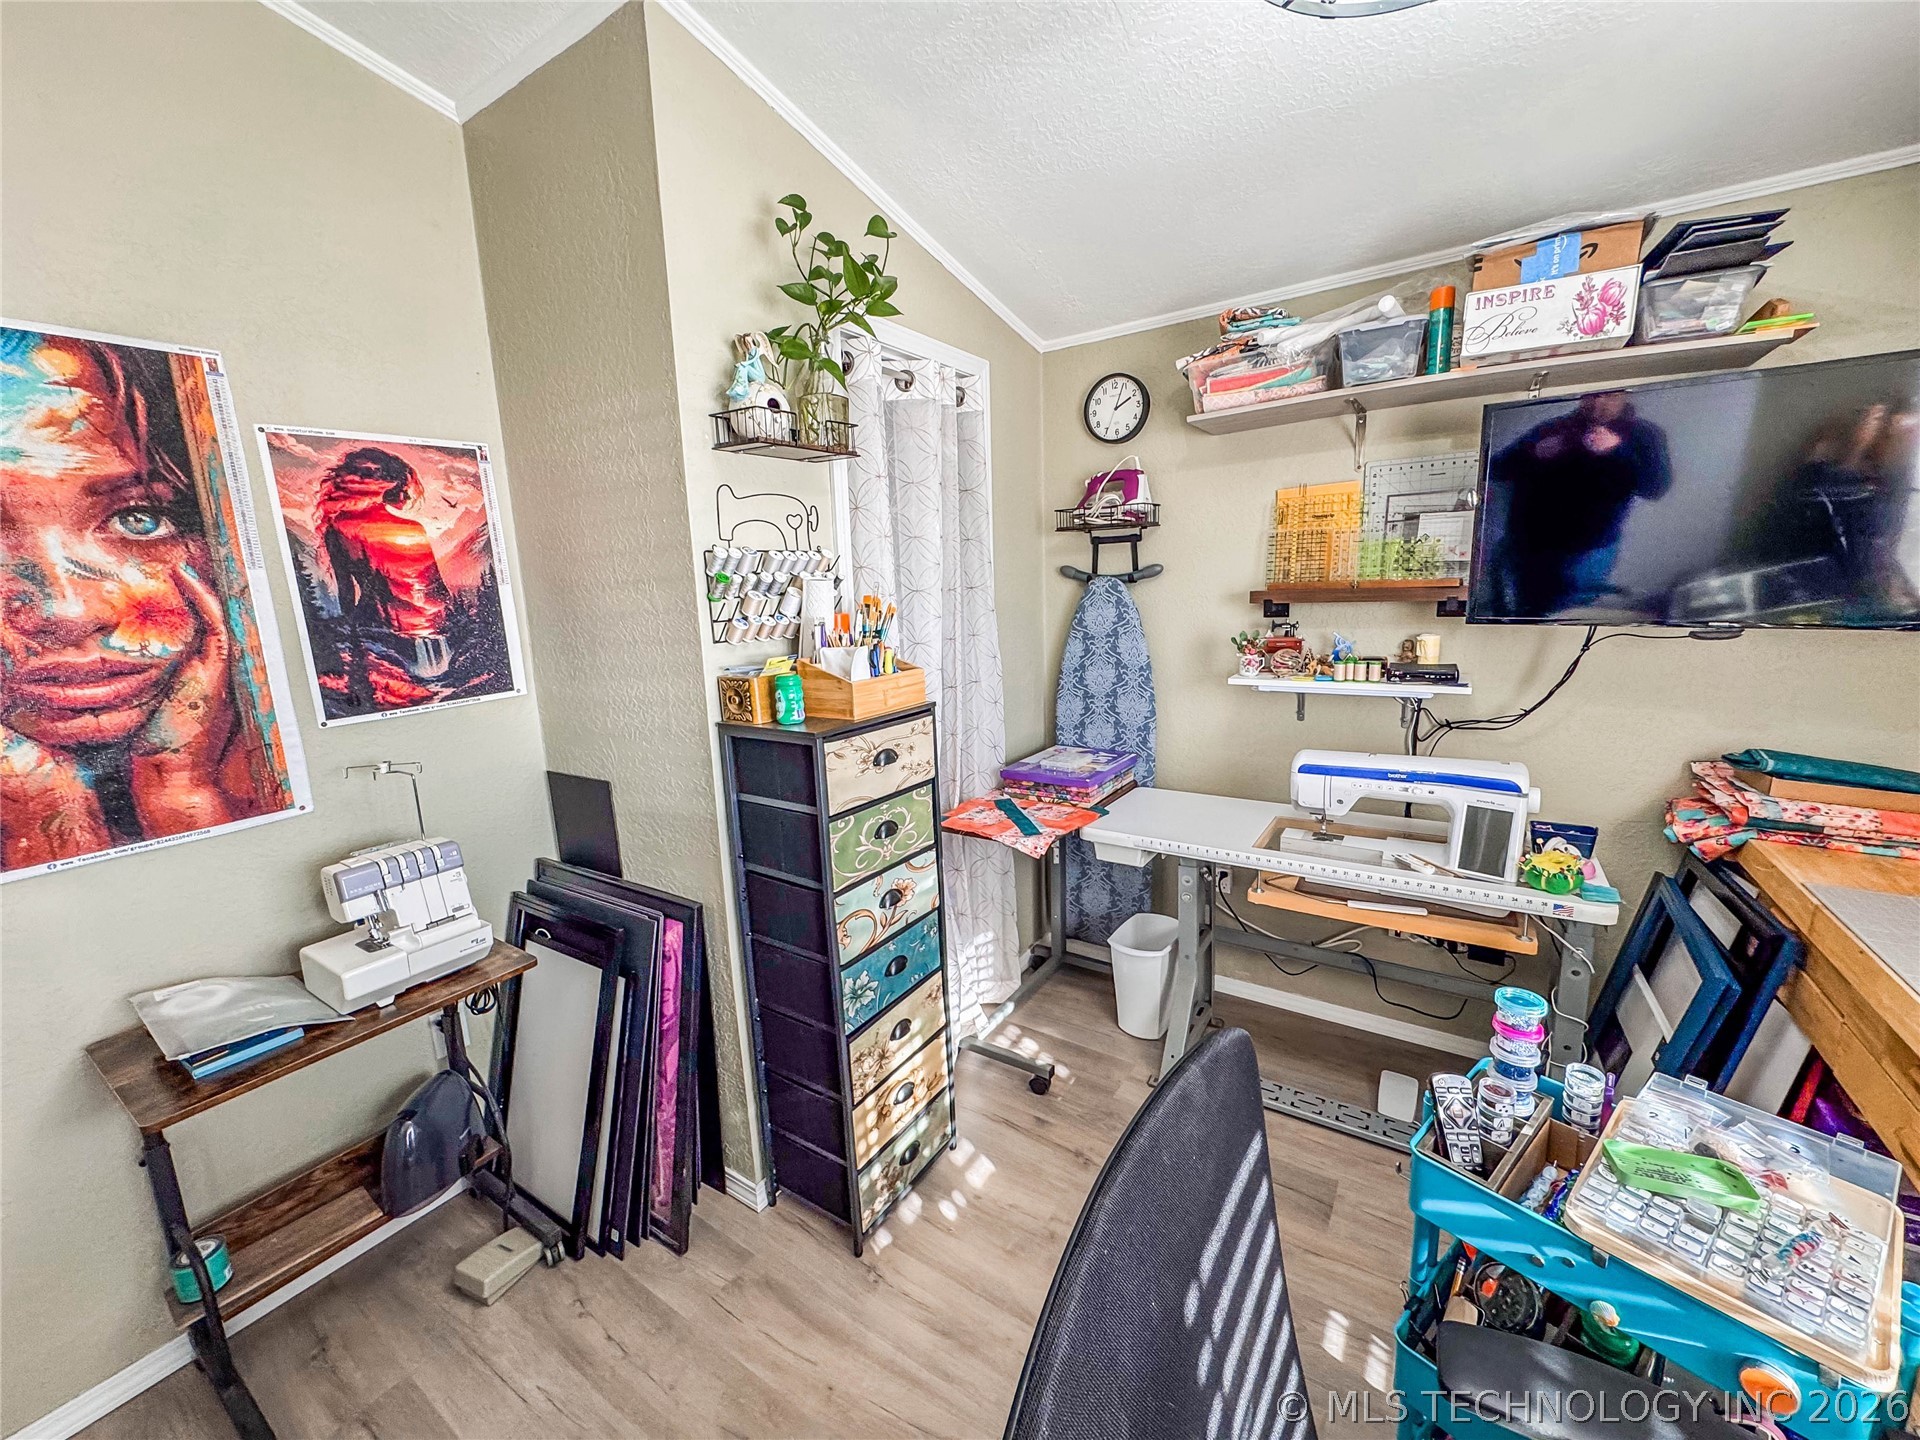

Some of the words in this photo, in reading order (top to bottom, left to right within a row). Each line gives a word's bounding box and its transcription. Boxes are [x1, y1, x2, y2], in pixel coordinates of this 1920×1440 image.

[1553, 254, 1560, 264] on
[1475, 284, 1556, 311] INSPIRE
[1465, 306, 1538, 353] Believe
[1102, 387, 1107, 395] 11
[1132, 389, 1137, 397] 2
[1136, 400, 1141, 408] 3
[1104, 427, 1109, 435] 7
